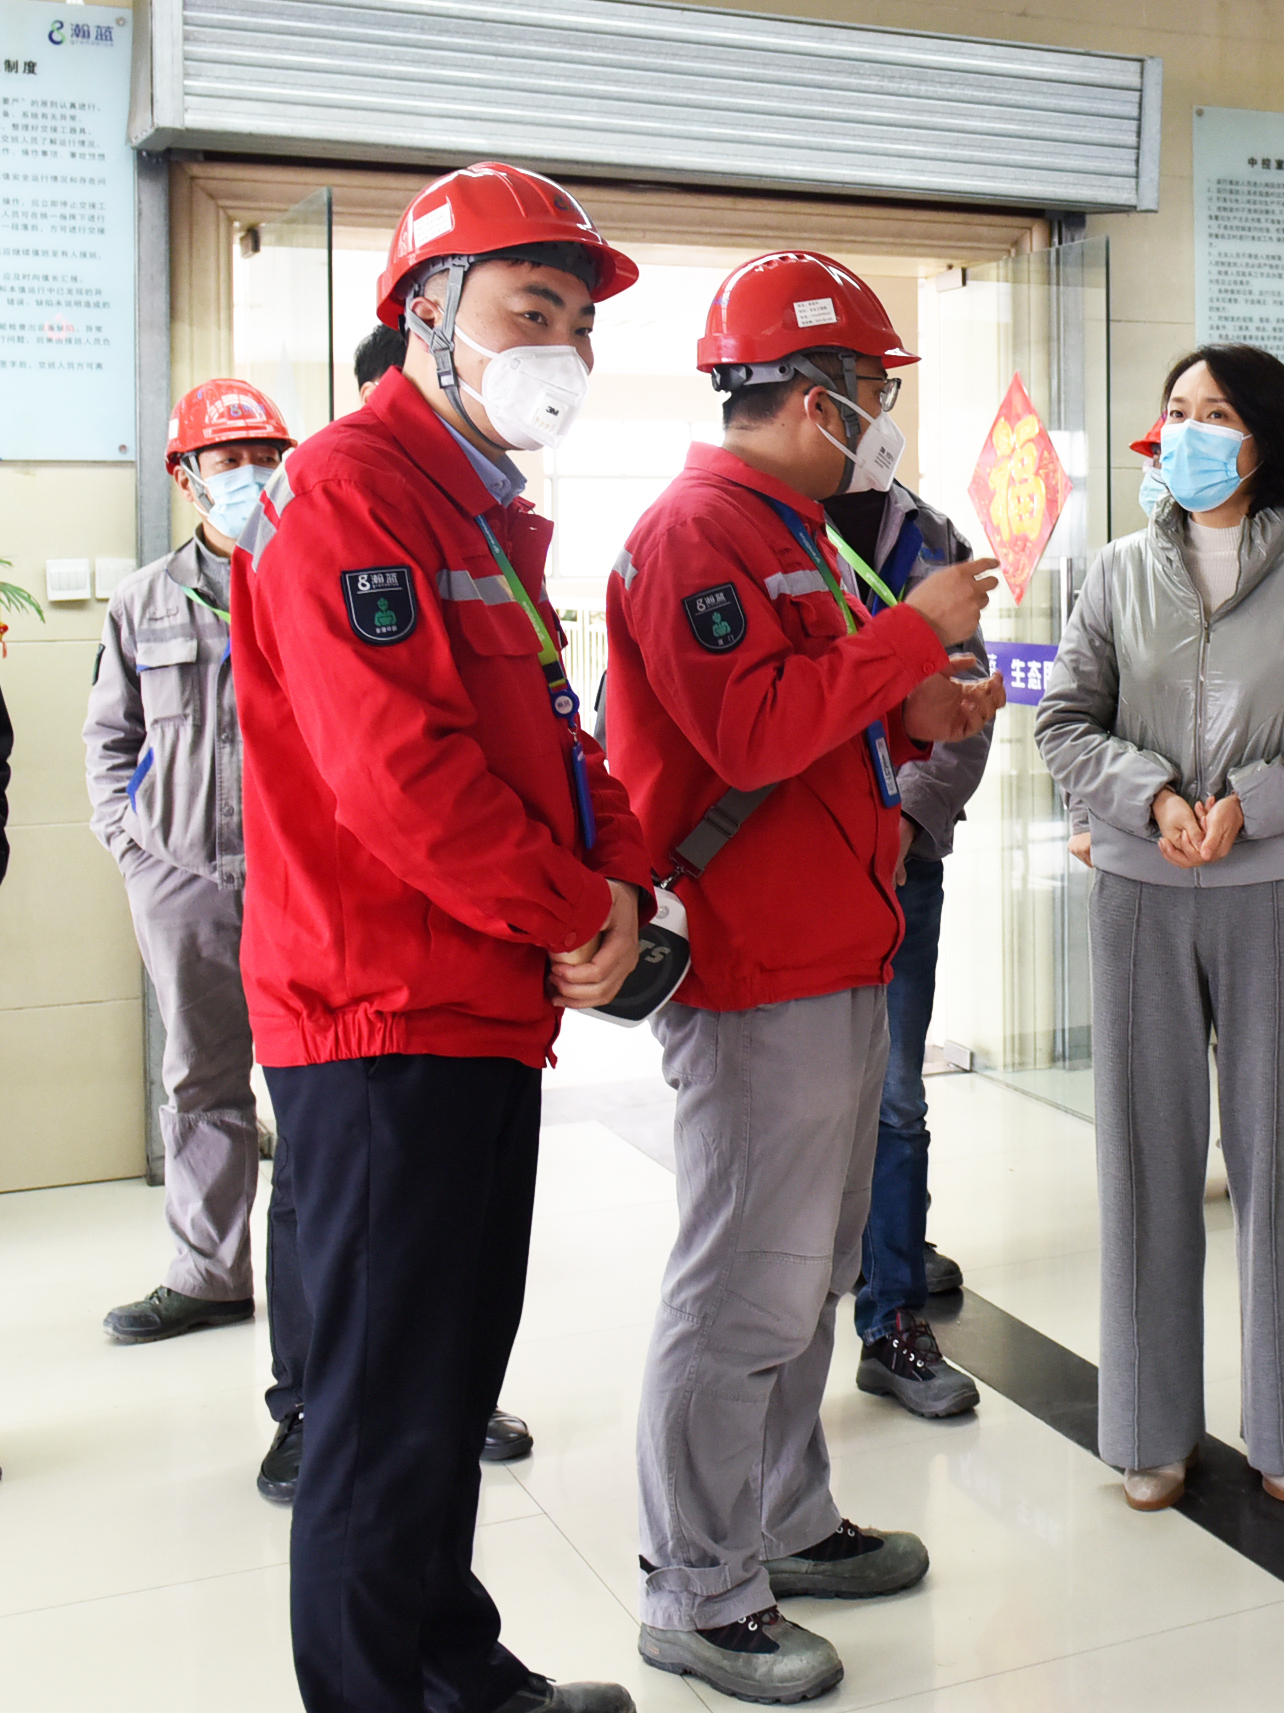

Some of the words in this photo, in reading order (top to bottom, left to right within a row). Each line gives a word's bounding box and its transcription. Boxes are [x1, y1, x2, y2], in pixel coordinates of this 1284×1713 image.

[71, 23, 114, 41] 瀚蓝
[4, 59, 38, 76] 制度
[545, 405, 560, 416] 3M
[988, 414, 1046, 542] 福
